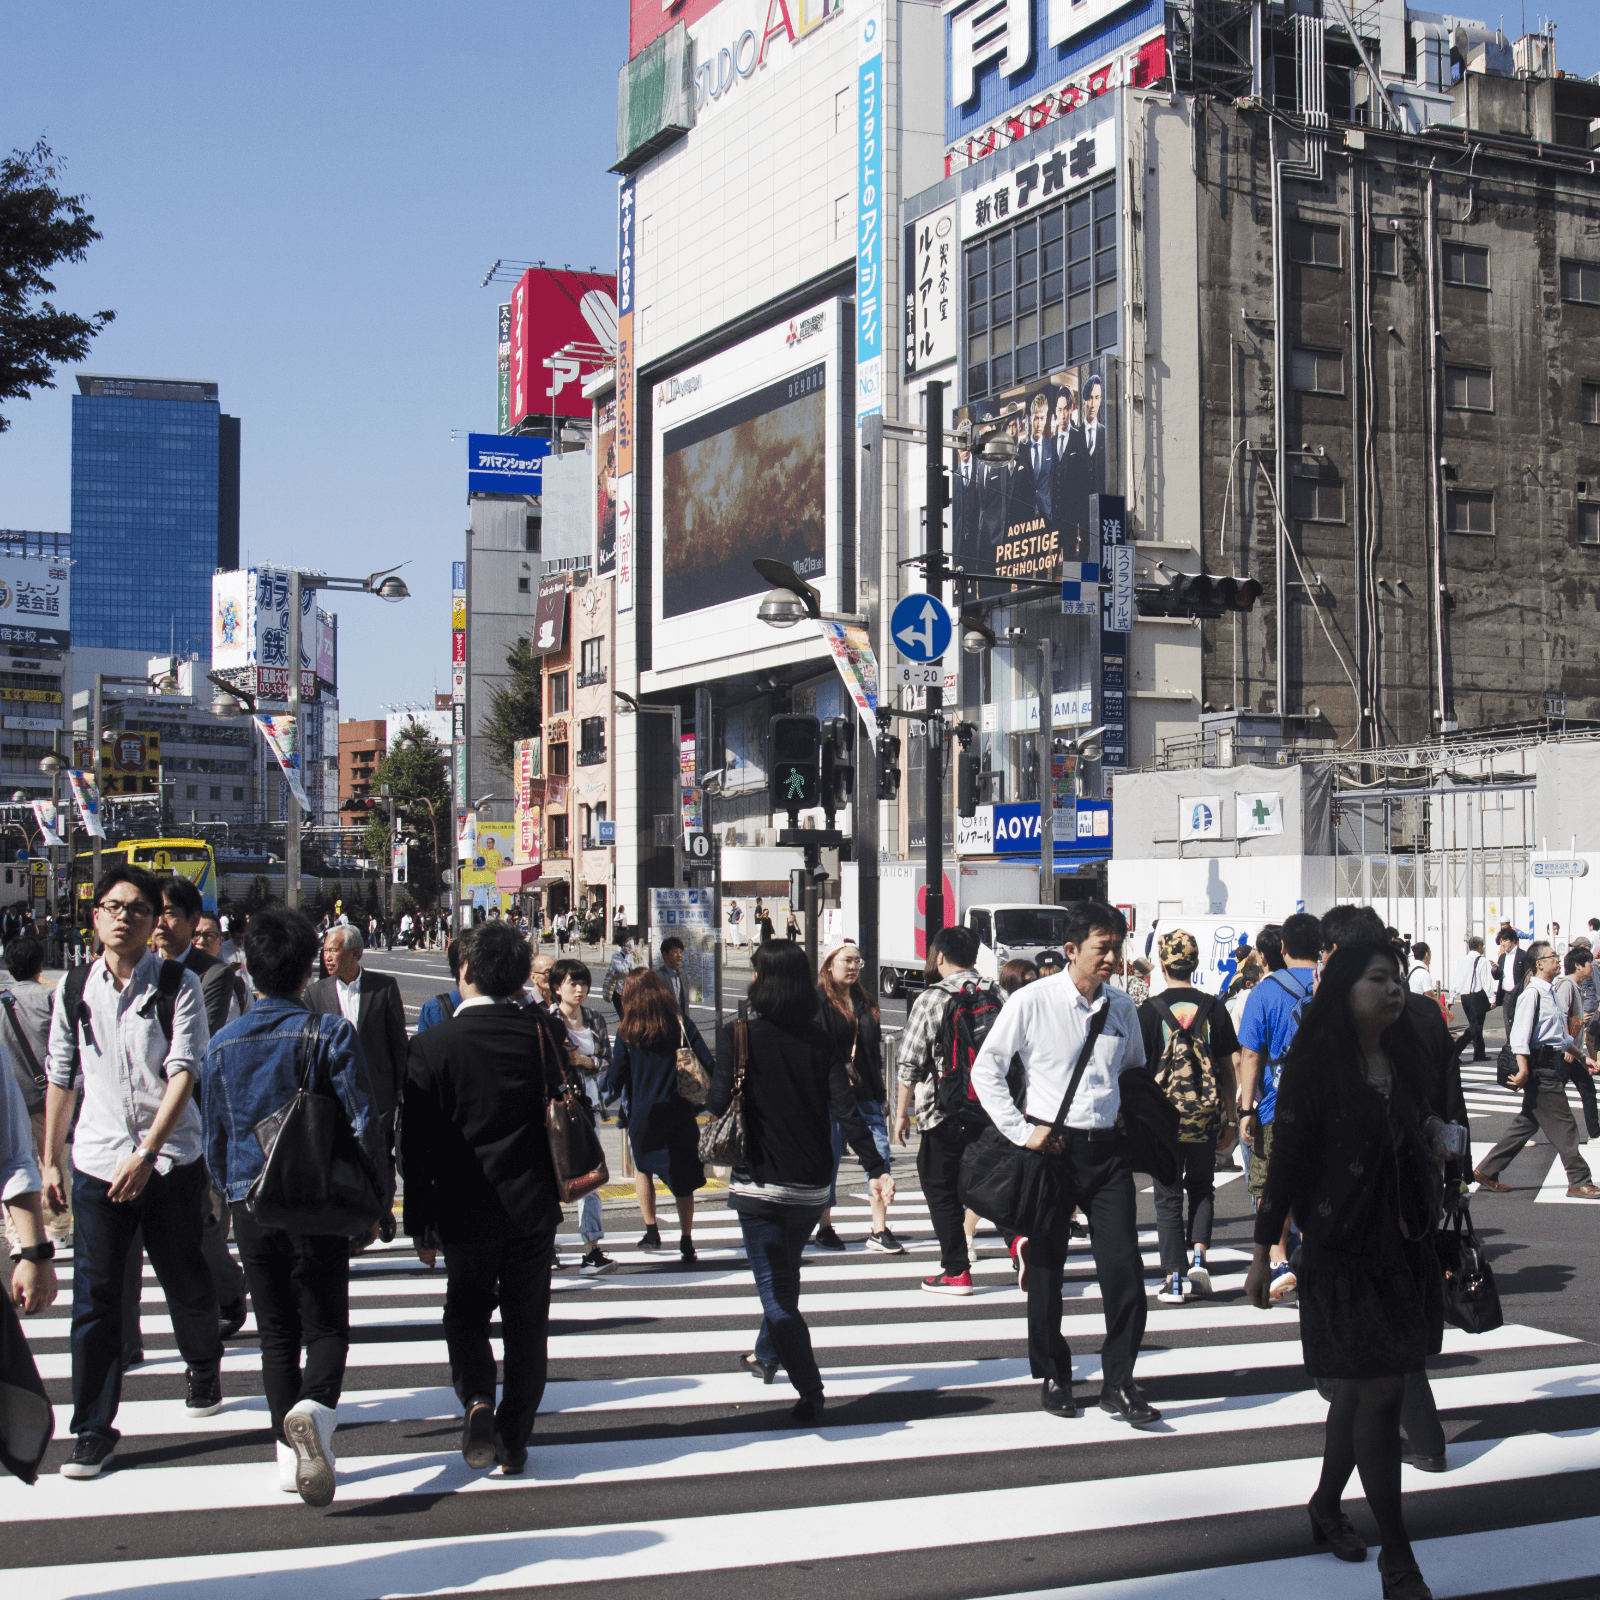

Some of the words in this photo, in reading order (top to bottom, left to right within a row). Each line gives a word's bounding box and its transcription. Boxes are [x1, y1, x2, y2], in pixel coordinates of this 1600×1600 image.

[694, 29, 757, 110] STUDIO
[861, 70, 878, 345] コンタクトのアイシティ
[919, 225, 935, 359] ルノアール
[515, 285, 524, 417] アイフル
[478, 455, 541, 470] アパマンショップ
[1008, 517, 1046, 538] AOYAMA
[995, 530, 1059, 563] PRESTIGE
[995, 552, 1058, 577] TECHNOLOGY
[16, 580, 59, 596] シェーン
[258, 569, 317, 616] カラケ
[1117, 549, 1130, 630] スクランブル式
[16, 593, 59, 613] 英会話
[1063, 601, 1096, 614] 時差式
[1031, 701, 1078, 719] AAMA
[121, 740, 142, 765] 質
[957, 830, 992, 844] ルノアール
[36, 862, 44, 872] 2
